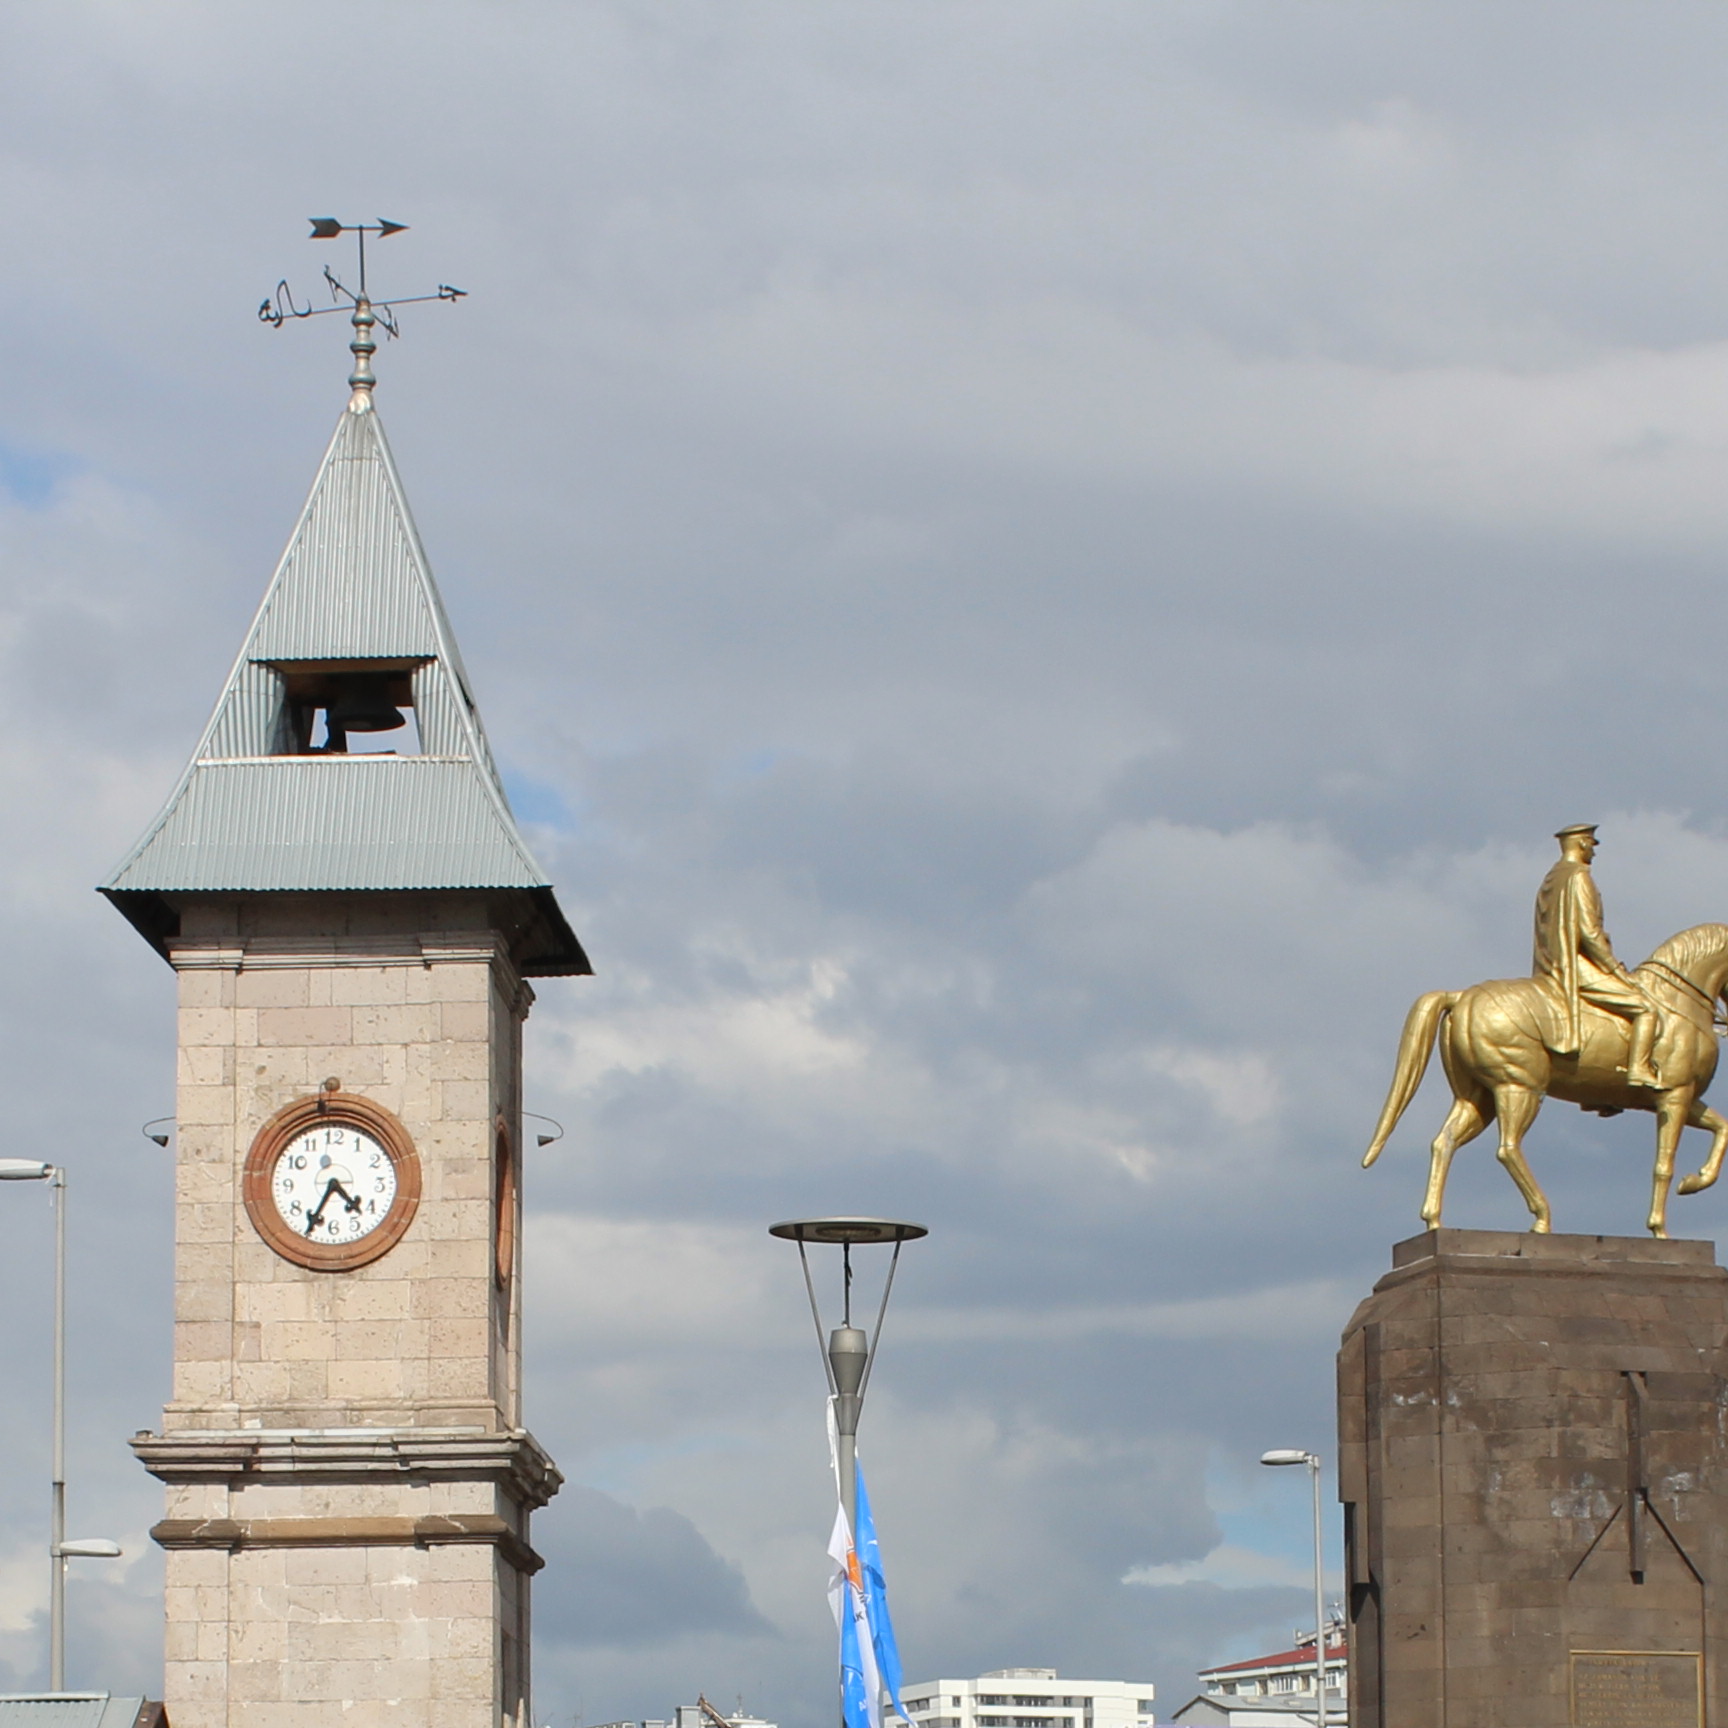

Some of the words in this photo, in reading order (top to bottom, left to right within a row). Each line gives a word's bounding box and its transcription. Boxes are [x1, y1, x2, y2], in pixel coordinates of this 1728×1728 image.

[304, 1138, 317, 1152] 11
[325, 1129, 344, 1145] 12
[354, 1137, 361, 1152] 1
[288, 1155, 307, 1170] 10
[368, 1153, 381, 1169] 2
[282, 1178, 294, 1193] 9
[374, 1177, 386, 1193] 3
[289, 1200, 302, 1216] 8
[366, 1198, 376, 1215] 4
[327, 1219, 340, 1235] 6
[349, 1216, 361, 1232] 5
